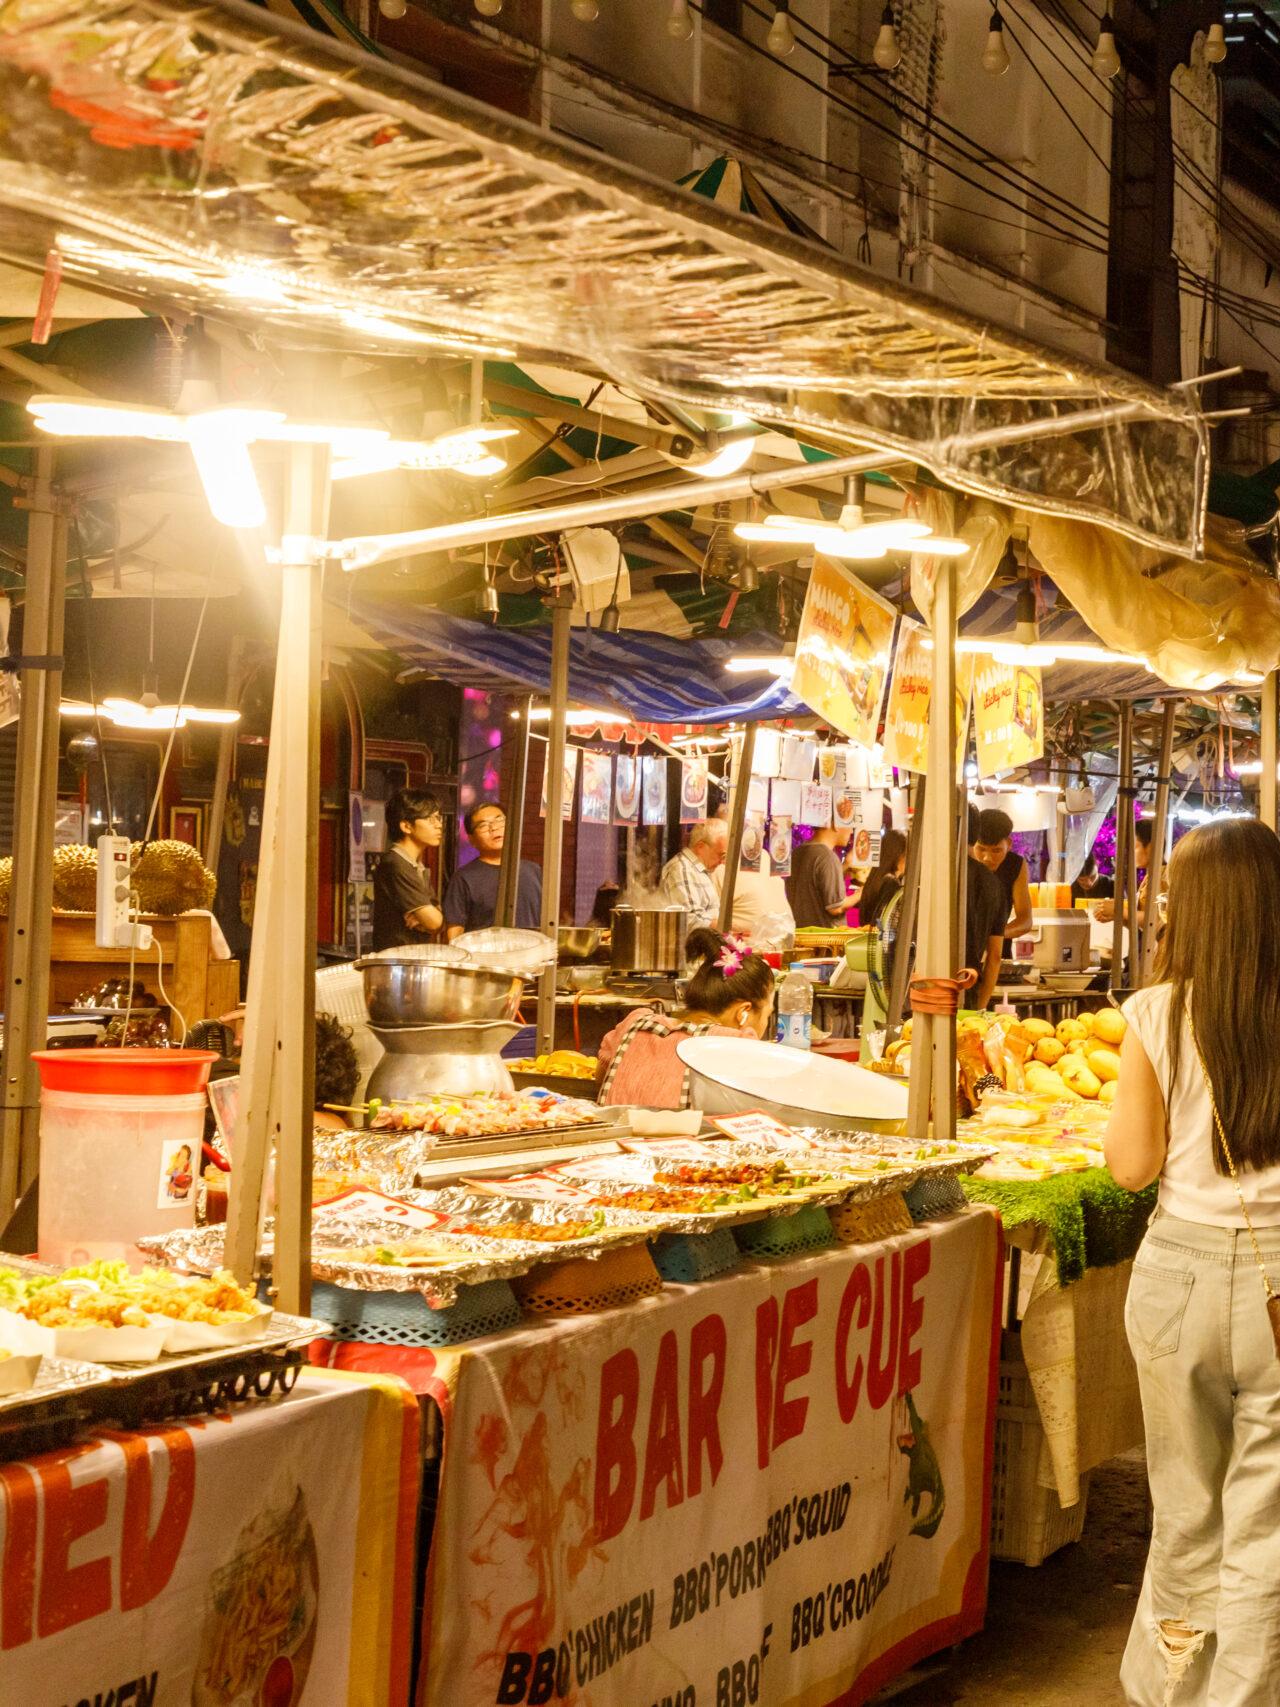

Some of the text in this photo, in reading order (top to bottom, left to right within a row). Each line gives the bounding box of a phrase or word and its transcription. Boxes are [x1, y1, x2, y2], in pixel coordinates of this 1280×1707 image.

[811, 582, 850, 626] MANGO
[593, 1312, 728, 1548] BAR
[835, 1237, 932, 1425] CUE
